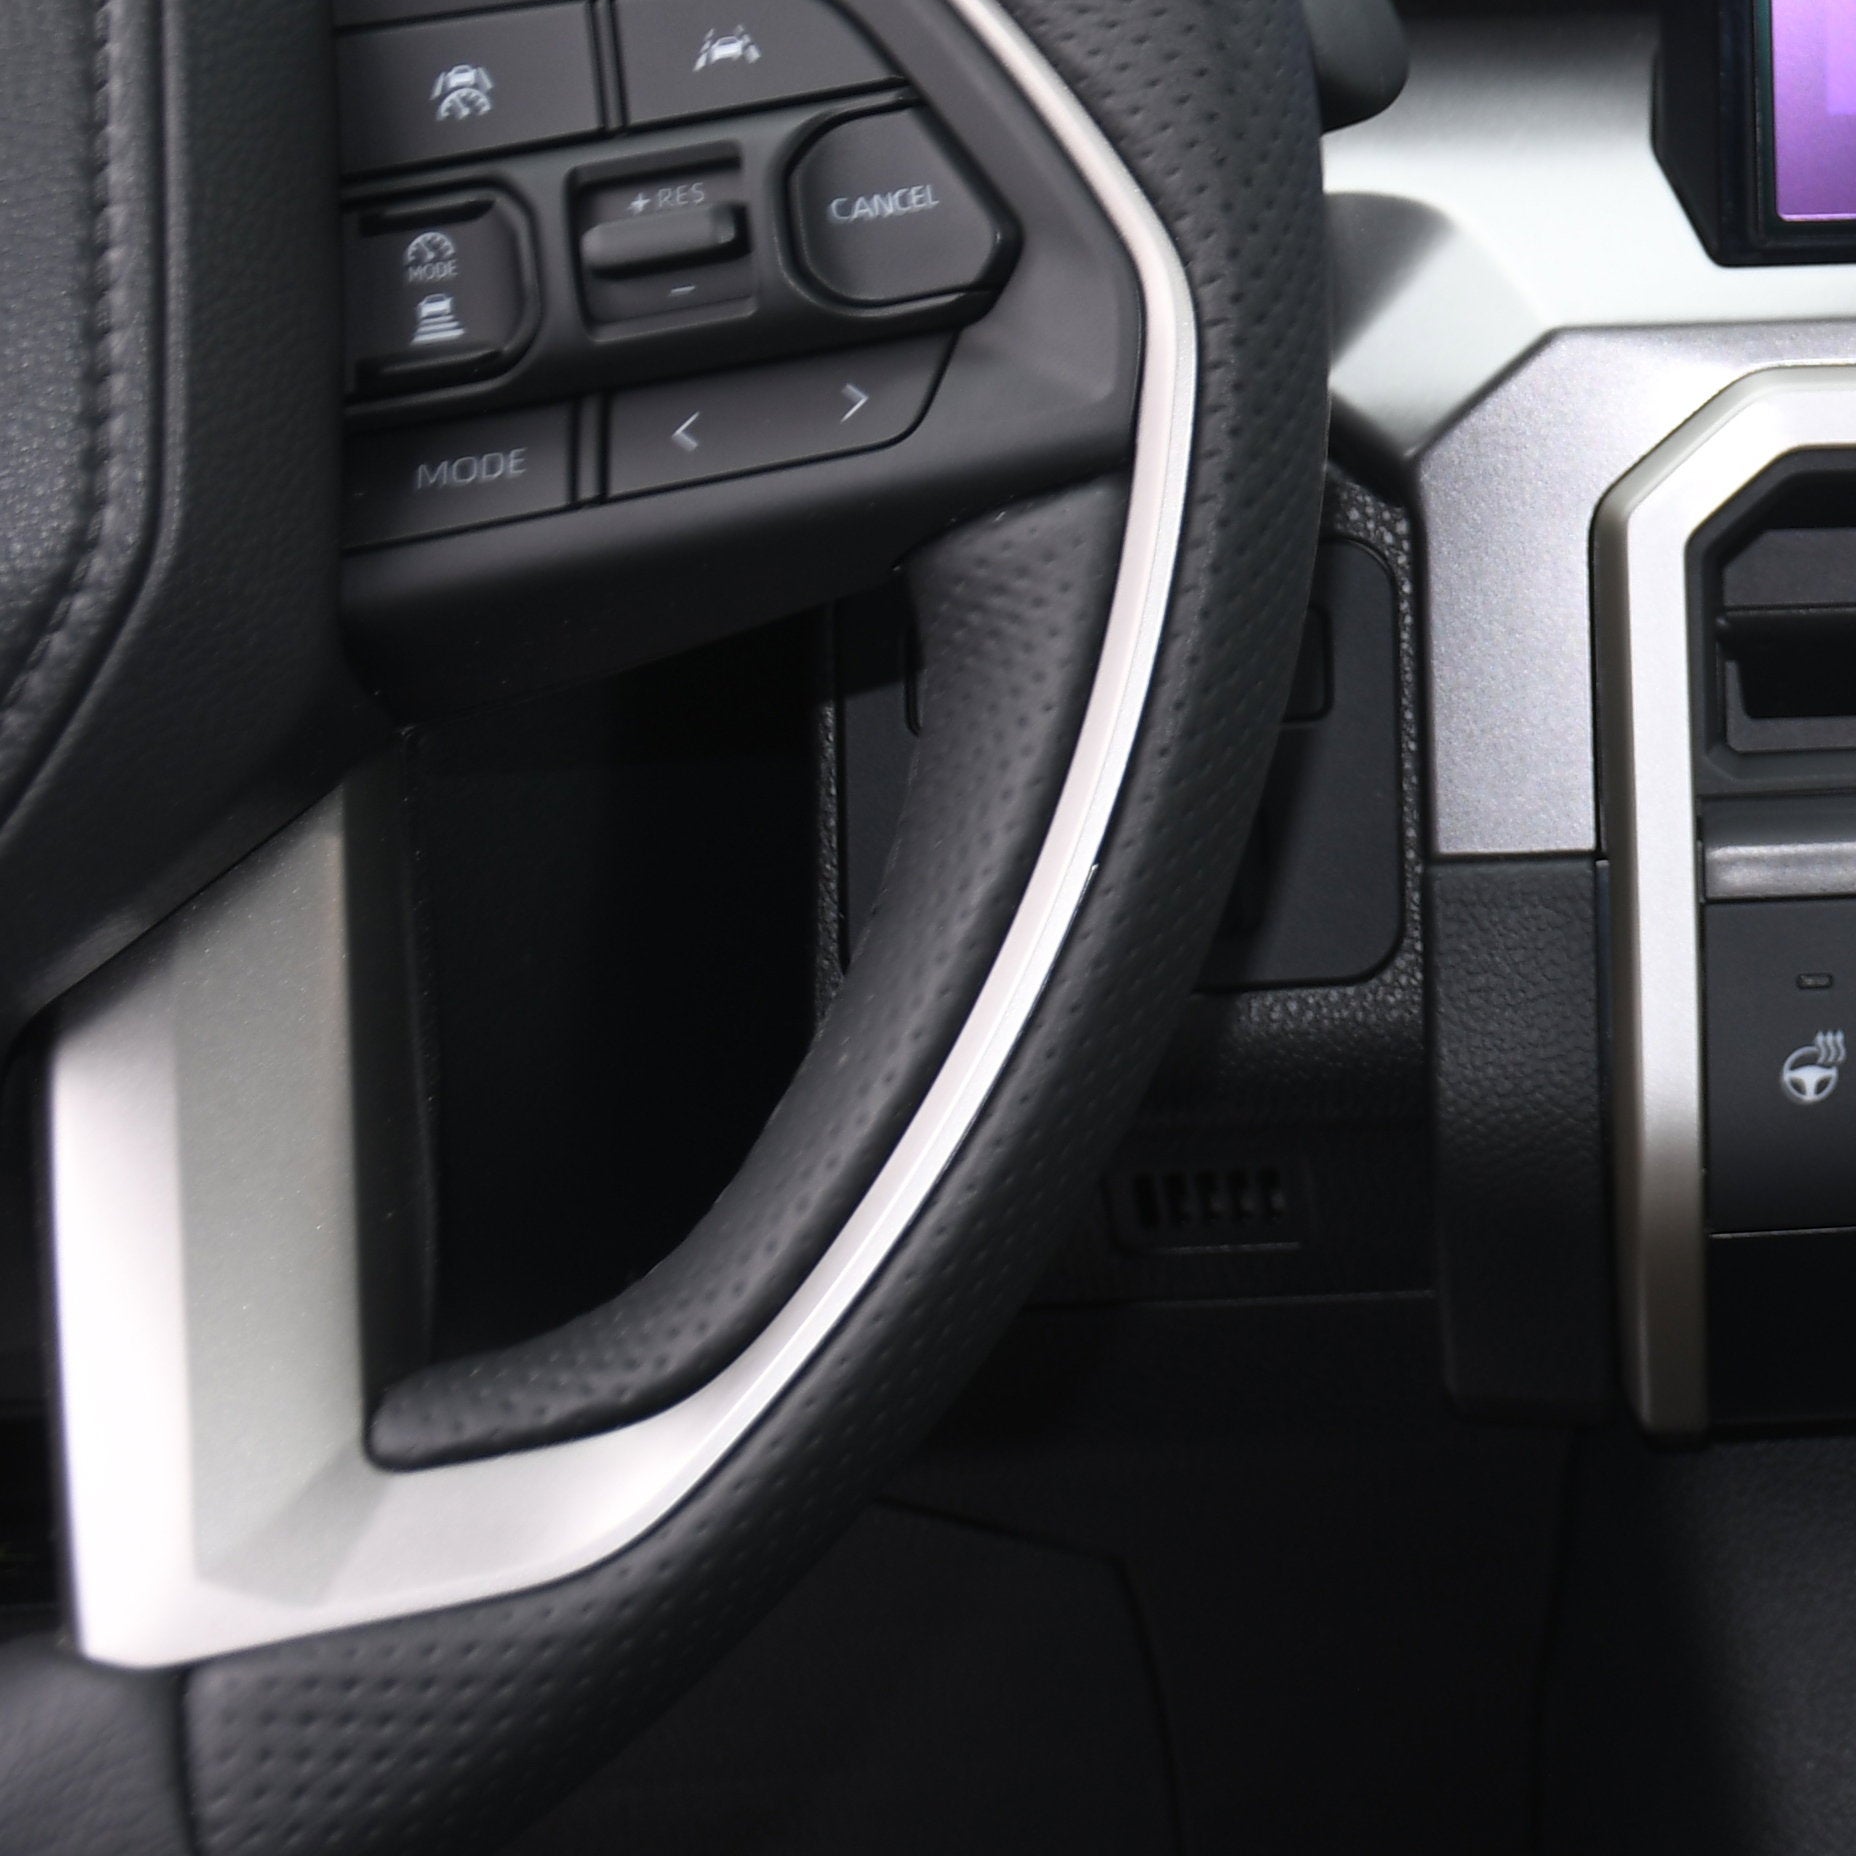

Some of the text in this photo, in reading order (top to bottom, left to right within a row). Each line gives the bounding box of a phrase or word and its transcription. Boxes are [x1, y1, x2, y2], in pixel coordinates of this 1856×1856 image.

[829, 183, 940, 225] CANCEL
[406, 258, 459, 283] MODE
[416, 446, 528, 490] MODE
